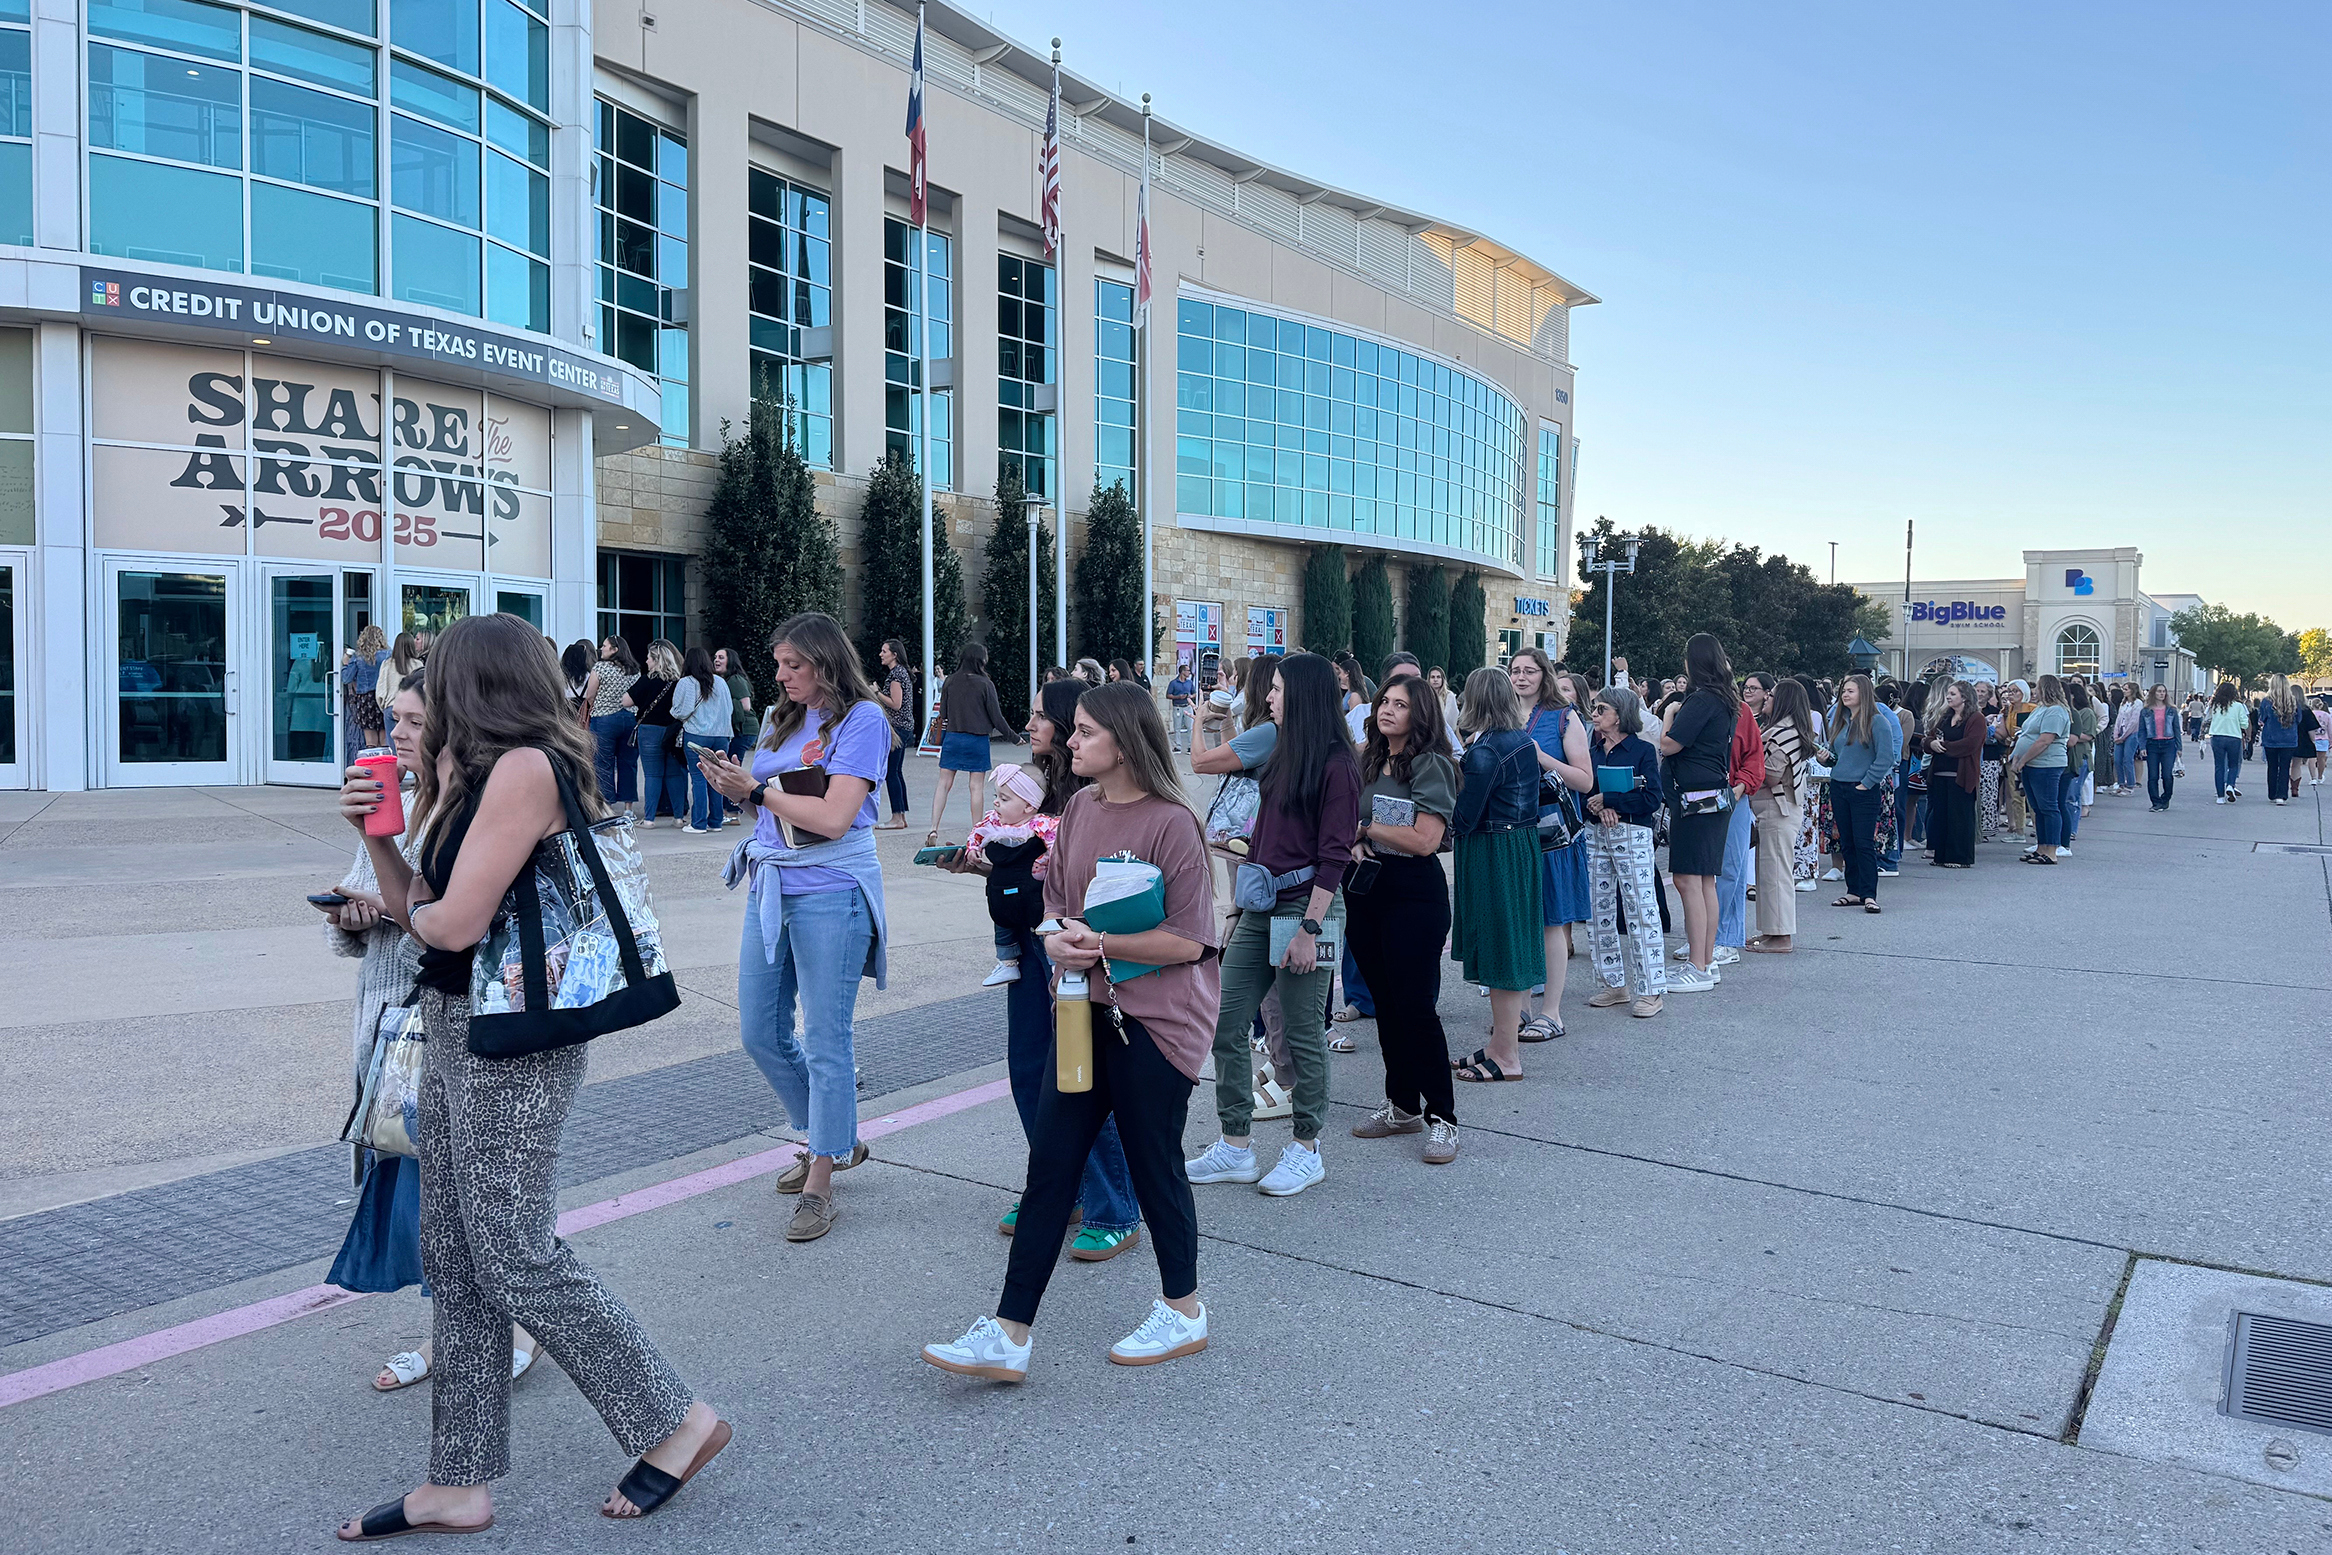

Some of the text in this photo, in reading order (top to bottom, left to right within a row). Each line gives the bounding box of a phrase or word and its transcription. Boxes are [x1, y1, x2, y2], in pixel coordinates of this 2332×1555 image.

[129, 286, 598, 391] CREDIT UNION OF TEXAS EVENT CENTER
[188, 372, 513, 460] SHARE The
[169, 432, 521, 521] ARROWS
[319, 506, 438, 548] 2025
[1514, 596, 1550, 617] TICKETS
[1911, 600, 2006, 626] BigBlue
